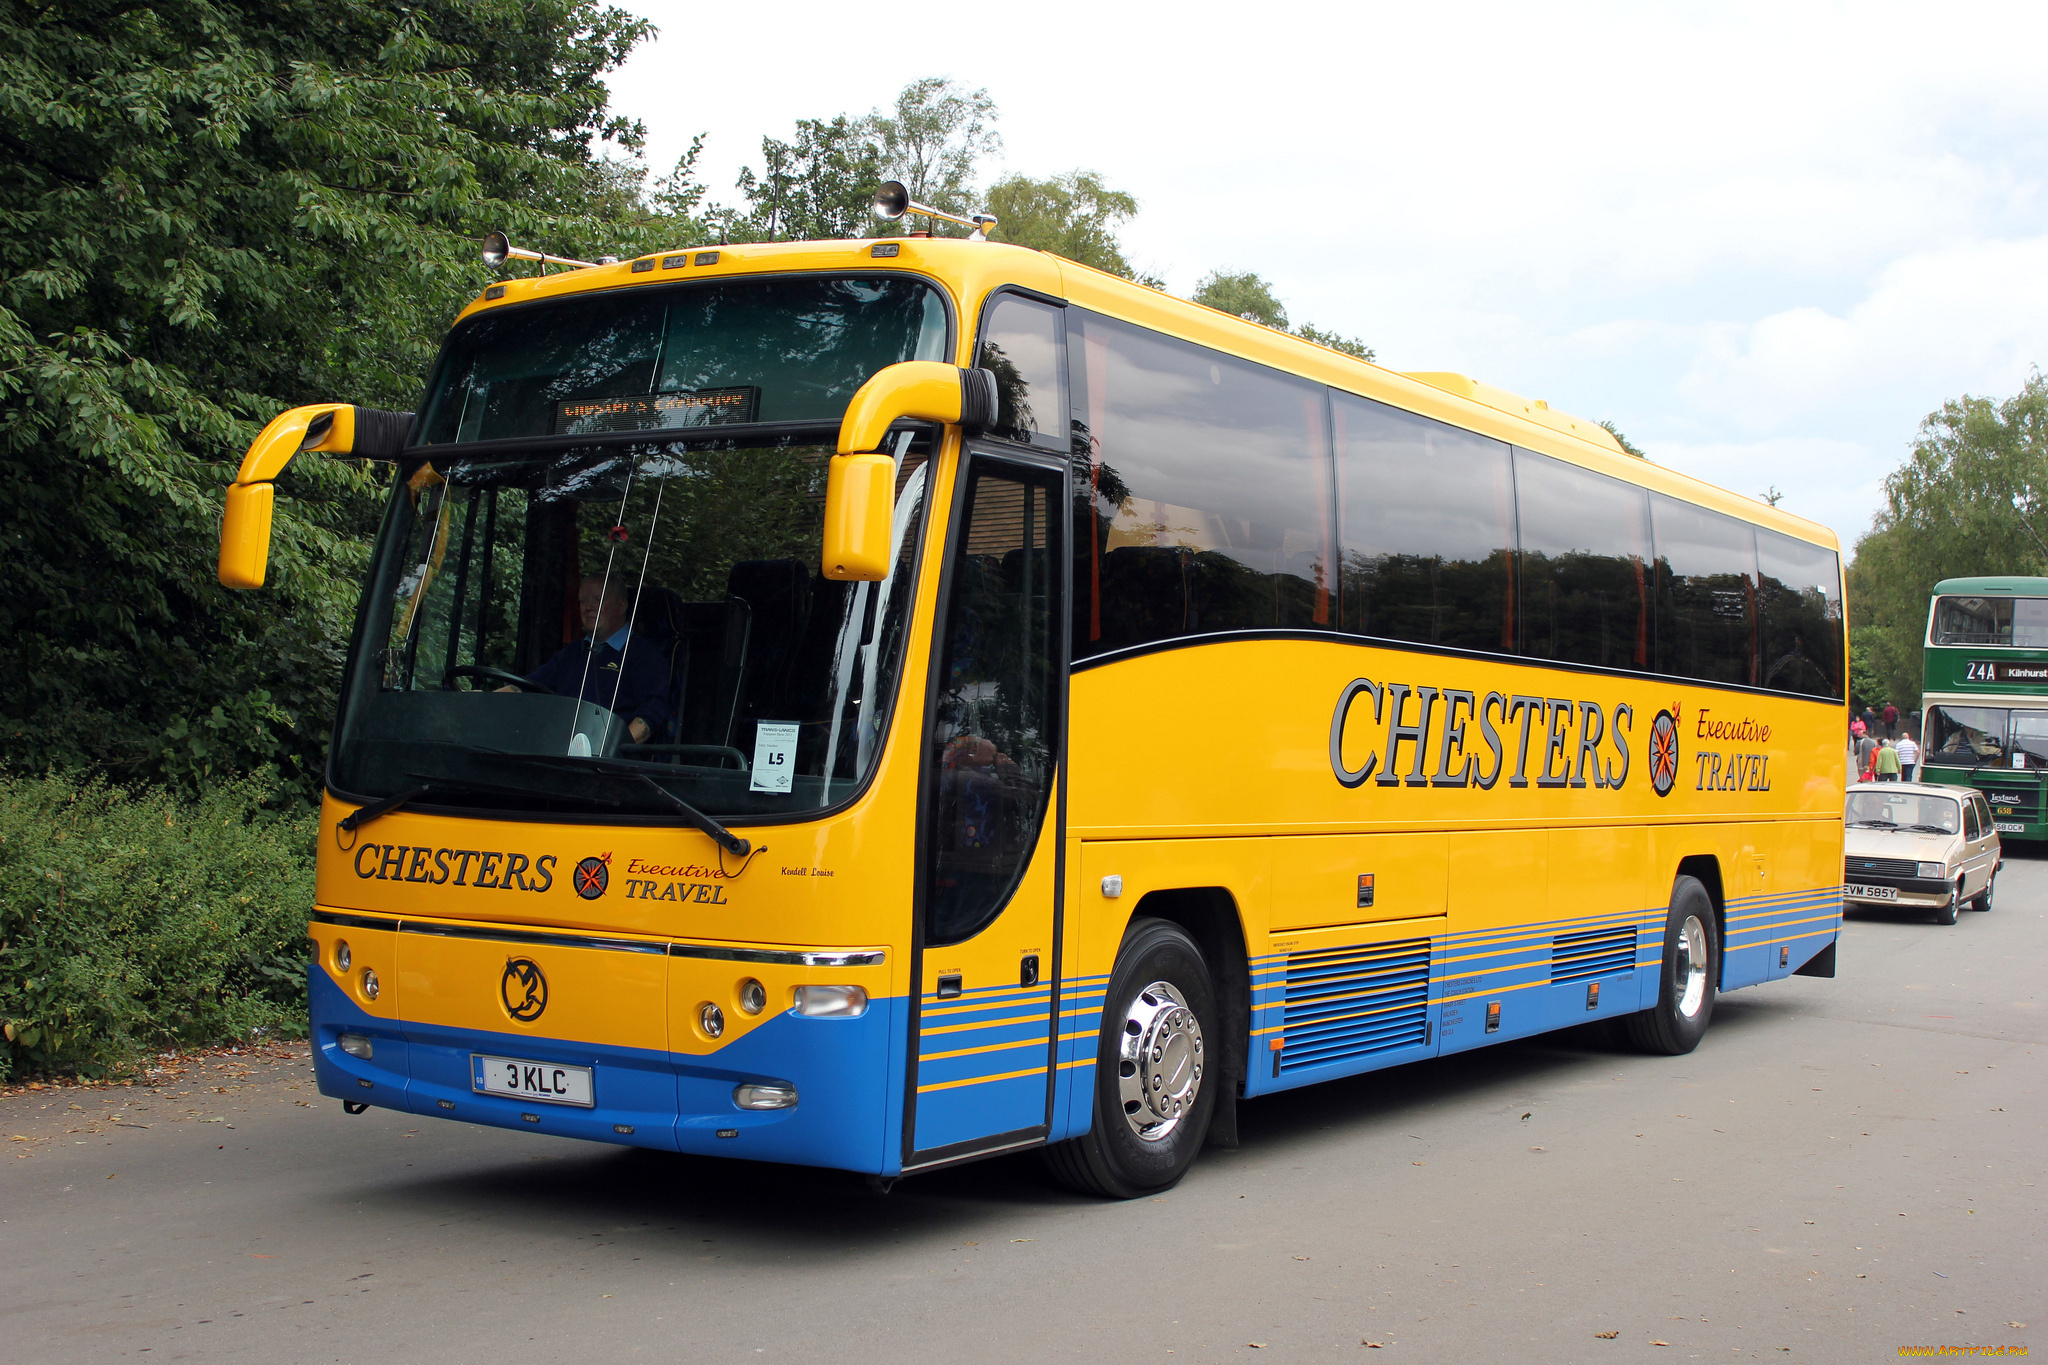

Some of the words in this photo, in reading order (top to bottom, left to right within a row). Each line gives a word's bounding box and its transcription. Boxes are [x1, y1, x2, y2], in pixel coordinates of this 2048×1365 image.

[1966, 662, 1995, 680] 24A
[2008, 668, 2048, 678] Kilnhurst
[1329, 677, 1633, 791] CHESTERS
[1696, 708, 1772, 743] Executive
[768, 752, 784, 766] L5
[1695, 751, 1772, 792] TRAVEL
[1990, 793, 2021, 804] Leyland
[1997, 807, 2012, 815] 658
[354, 842, 558, 893] CHESTERS
[627, 858, 729, 879] Executive
[781, 866, 807, 876] Kendell
[811, 867, 834, 877] Louise
[625, 879, 728, 905] TRAVEL
[1843, 885, 1864, 895] EVM
[1866, 887, 1896, 899] 585Y
[506, 1063, 519, 1089] 3
[524, 1066, 567, 1095] KLC
